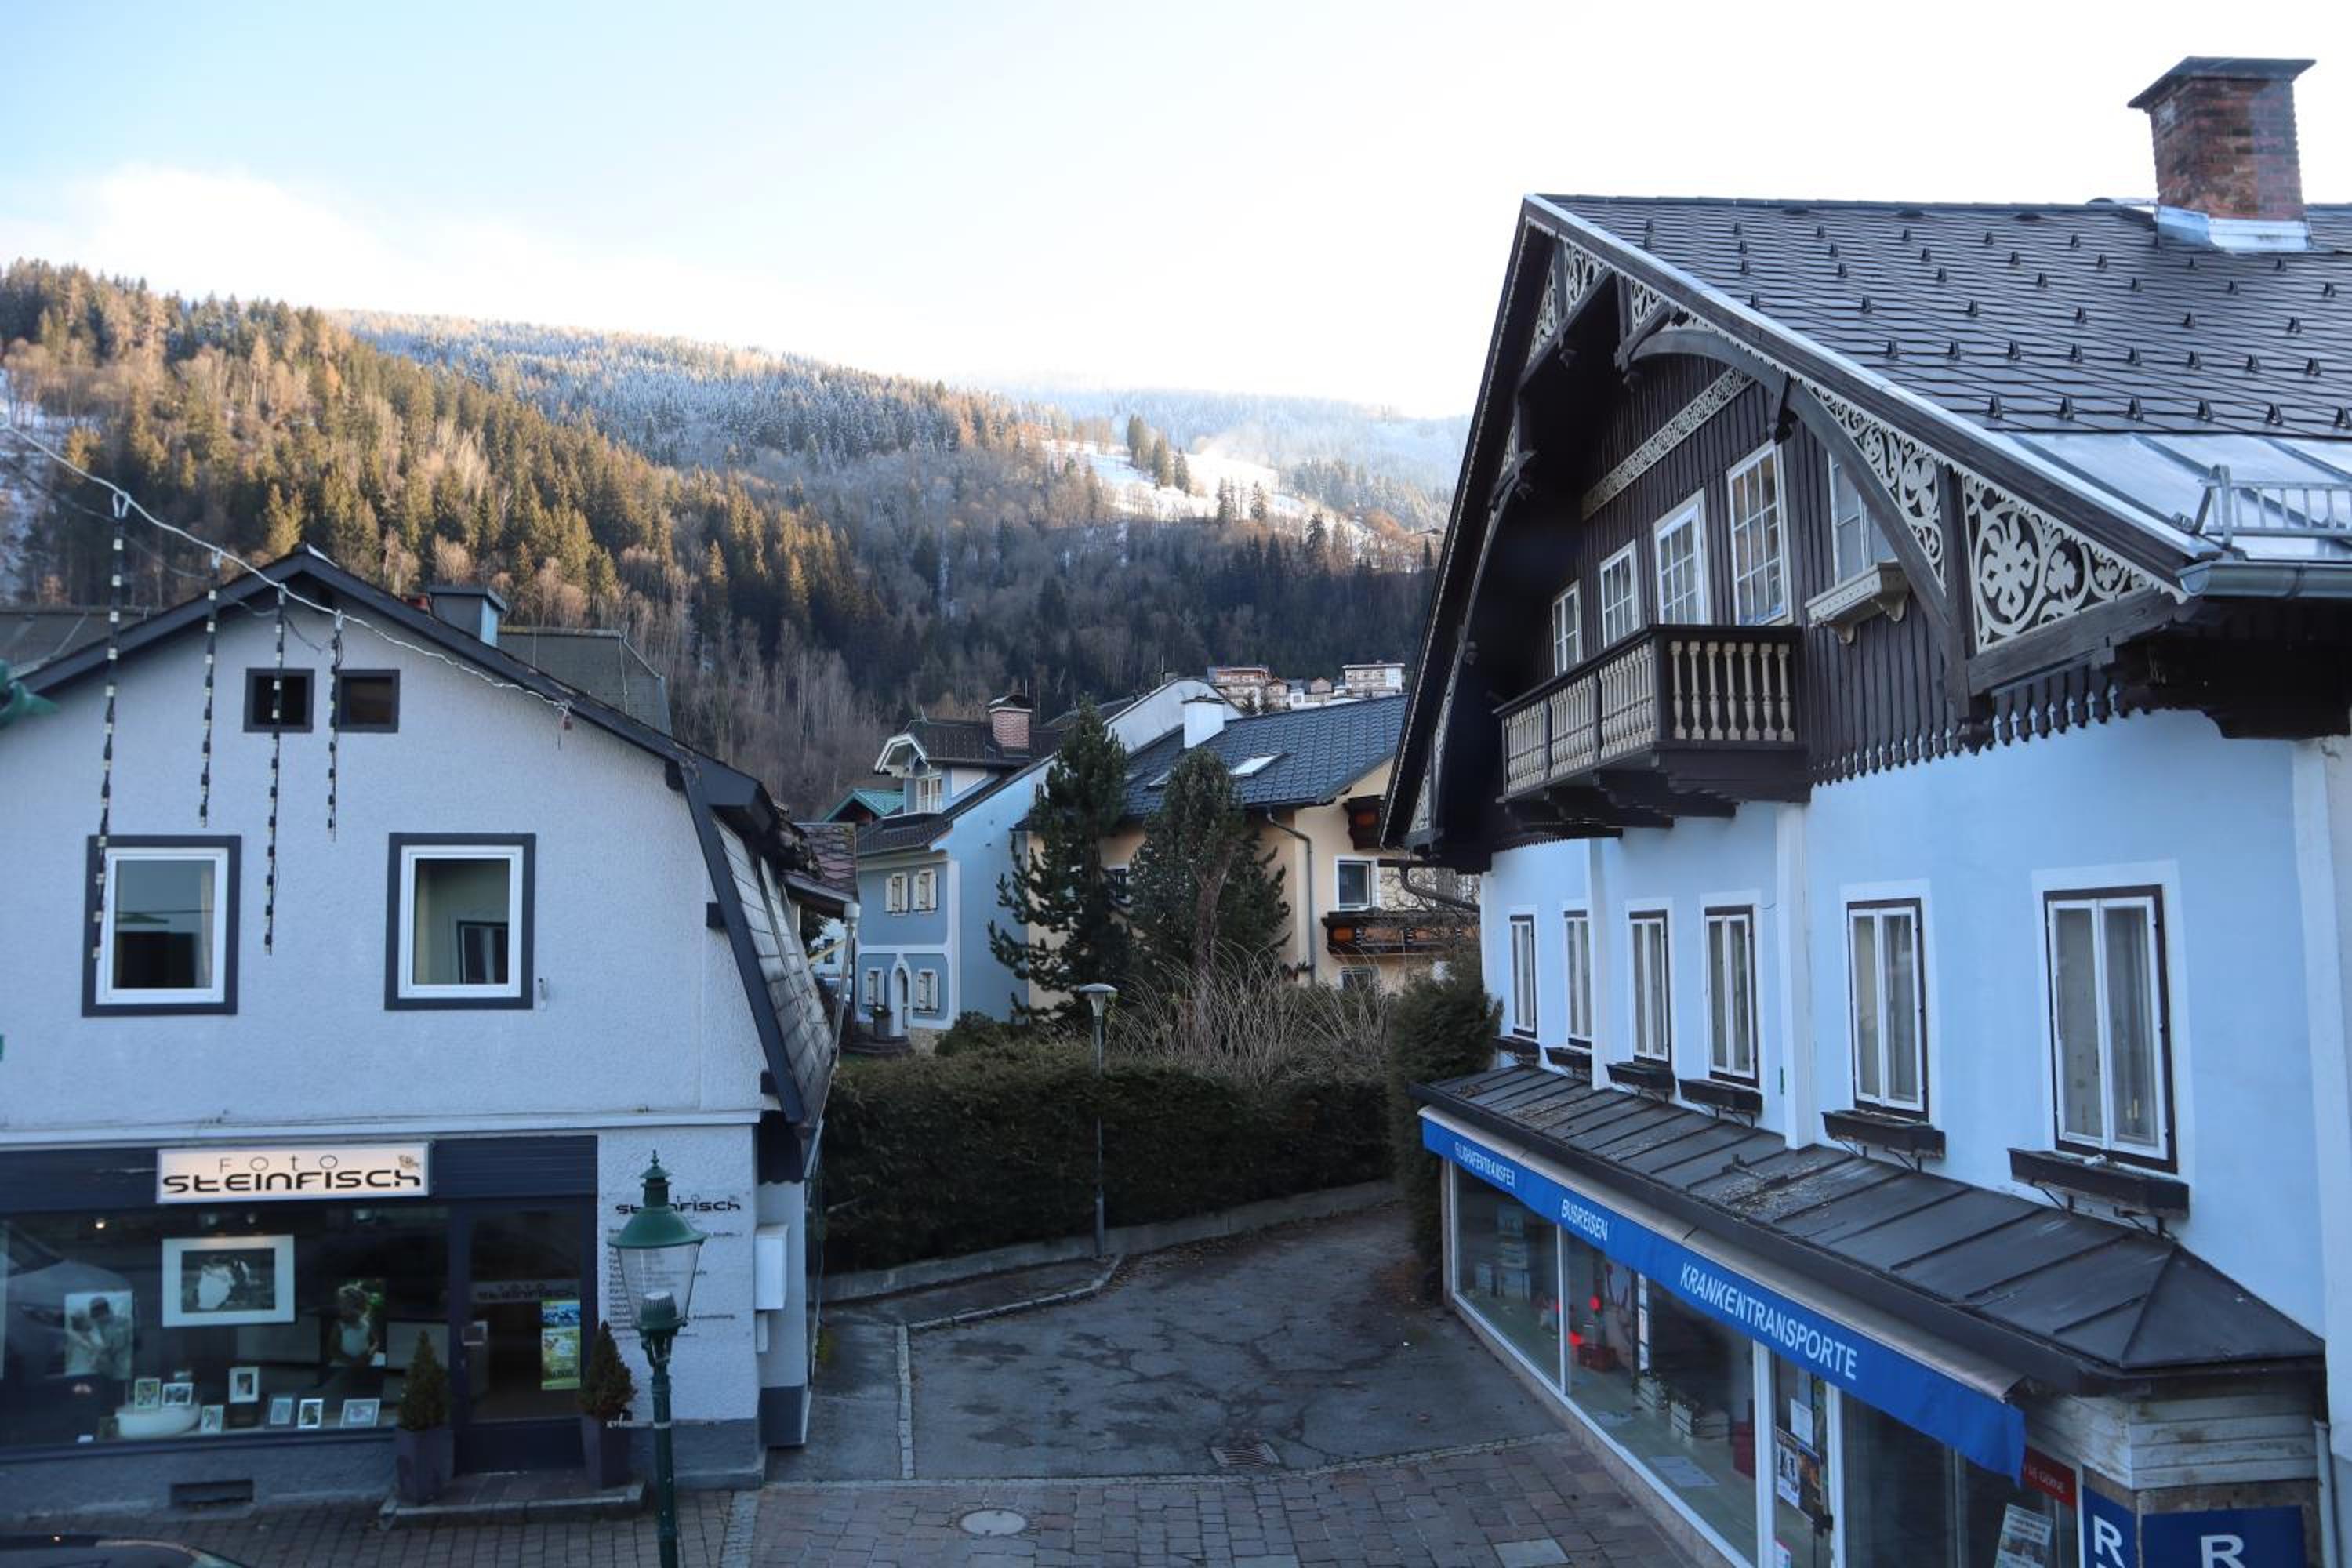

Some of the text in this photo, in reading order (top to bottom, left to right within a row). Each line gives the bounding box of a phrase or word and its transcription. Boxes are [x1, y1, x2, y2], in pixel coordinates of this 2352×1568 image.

[1561, 1198, 1609, 1242] BUSREISEN
[1680, 1262, 1858, 1381] KRANKENTRANSPORTE
[2094, 1514, 2126, 1568] R
[2201, 1534, 2247, 1568] R
